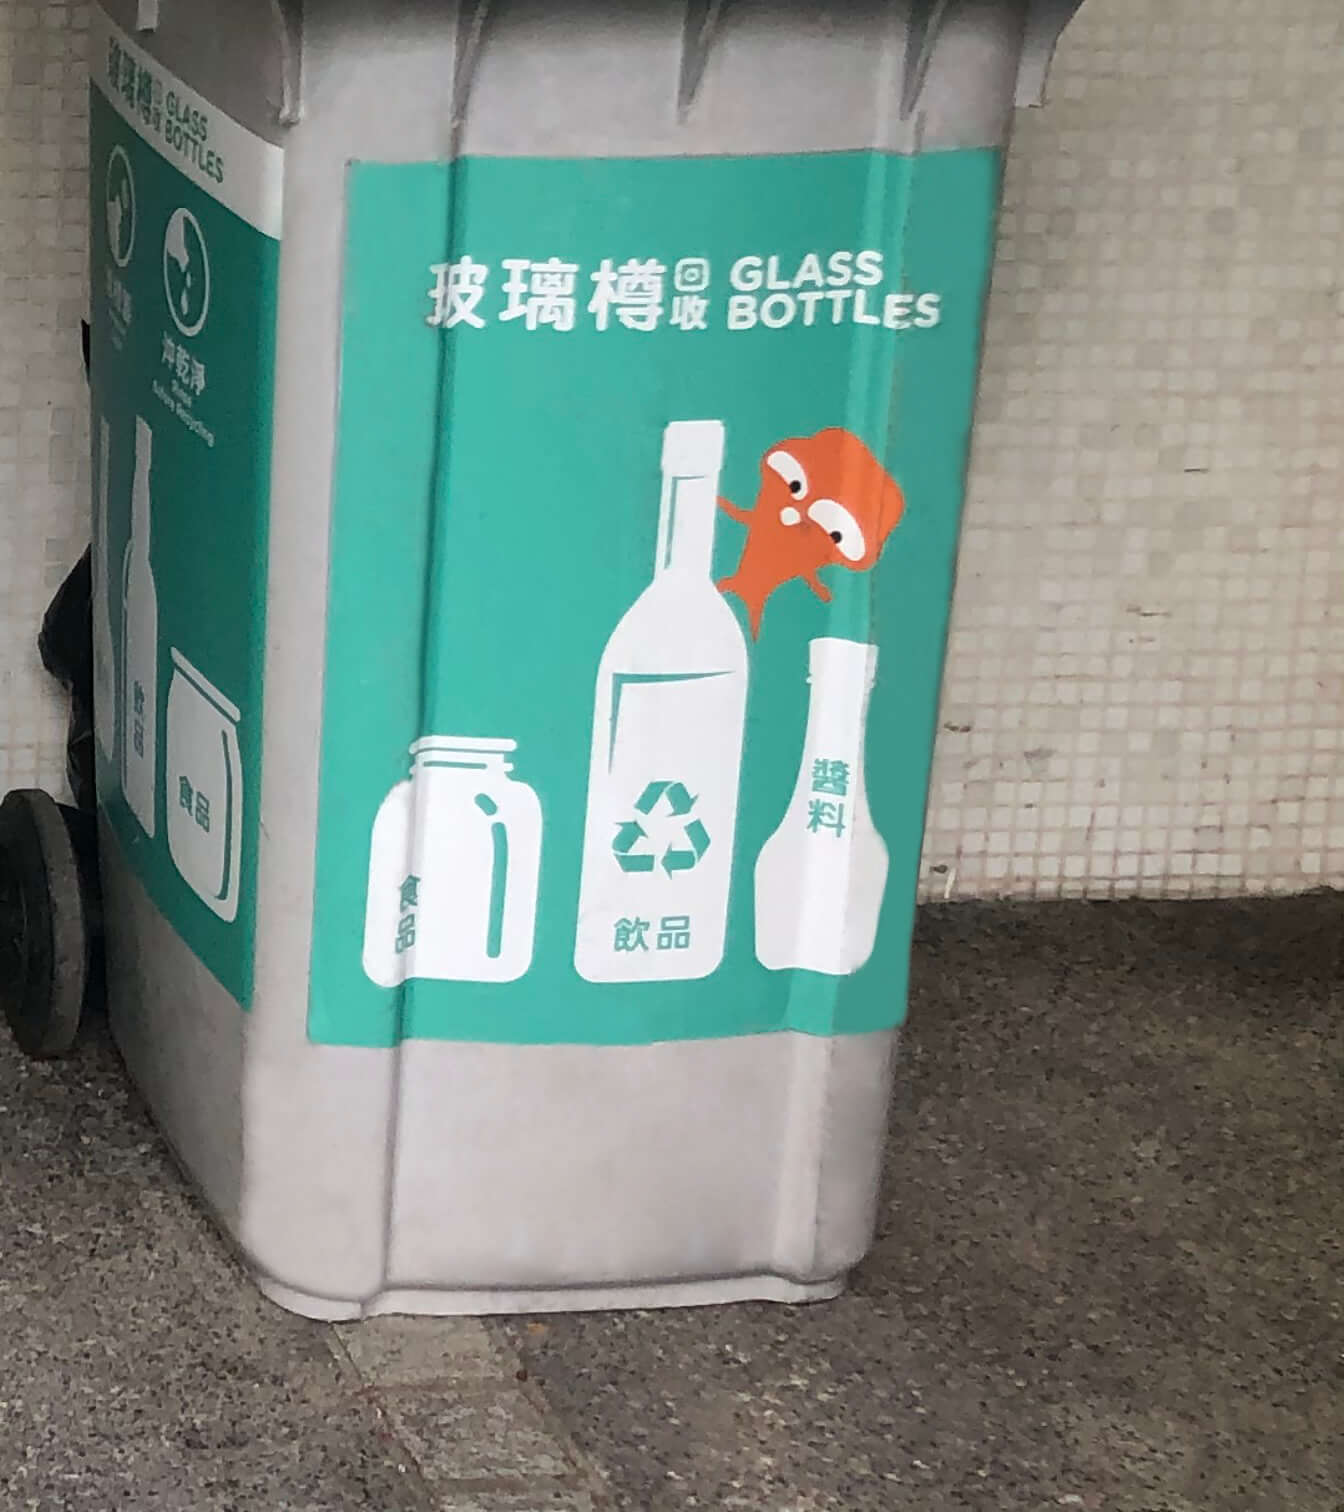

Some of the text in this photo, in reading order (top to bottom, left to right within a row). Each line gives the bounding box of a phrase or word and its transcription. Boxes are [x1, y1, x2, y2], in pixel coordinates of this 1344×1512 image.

[166, 90, 208, 141] GLASS
[165, 119, 224, 184] BOTTLES
[425, 255, 667, 332] 玻璃樽
[729, 250, 884, 291] GLASS
[727, 289, 941, 331] BOTTLES
[806, 758, 850, 838] 醬料
[614, 915, 691, 952] 飲品
